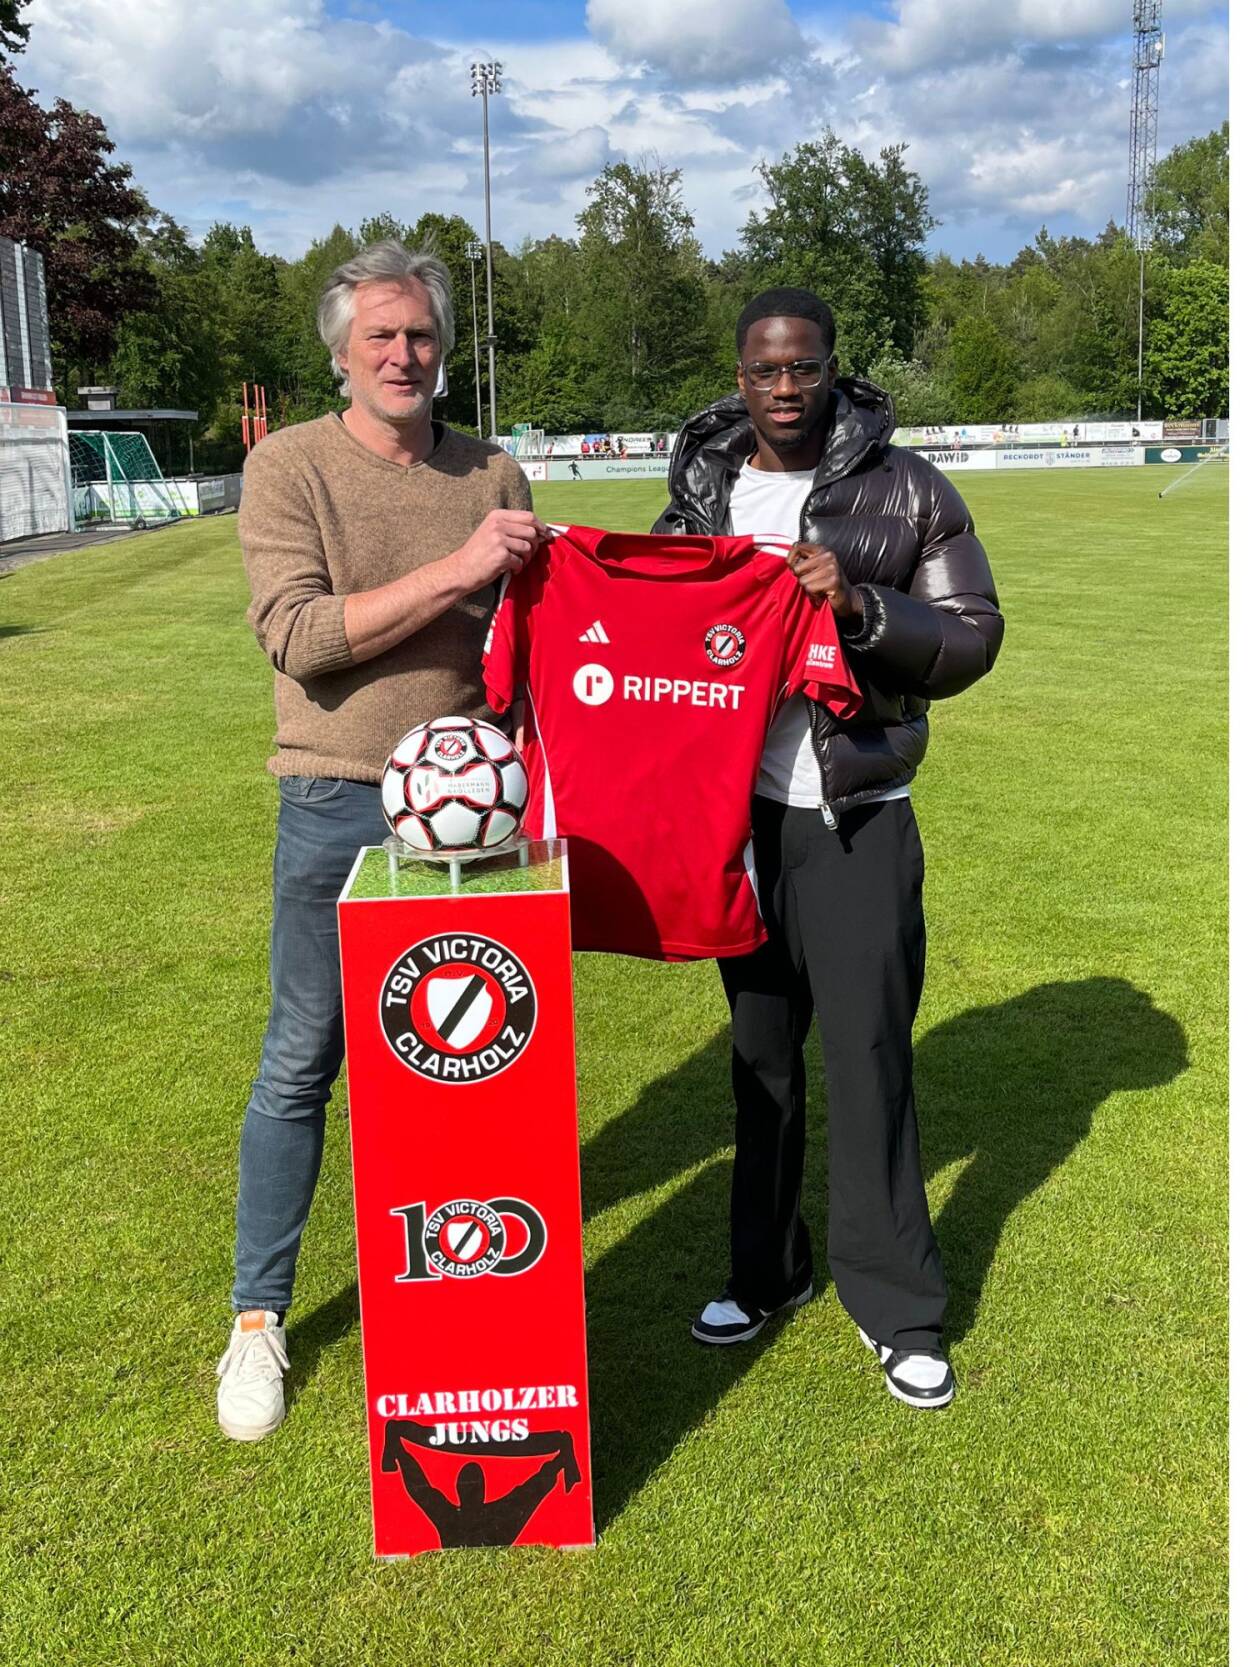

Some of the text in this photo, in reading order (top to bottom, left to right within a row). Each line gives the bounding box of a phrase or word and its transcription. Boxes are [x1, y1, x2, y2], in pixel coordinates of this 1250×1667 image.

[606, 464, 646, 474] Champions
[714, 624, 745, 644] VICTORIA
[706, 649, 743, 666] CLARHOLZ
[623, 675, 745, 710] RIPPERT
[386, 938, 528, 1008] TSV VICTORIA
[395, 1025, 526, 1079] CLARHOLZ
[426, 1202, 501, 1239] TSV VICTORIA
[431, 1247, 500, 1276] CLARHOLZ
[376, 1385, 579, 1417] CLARHOLZER
[428, 1418, 530, 1446] JUNGS
